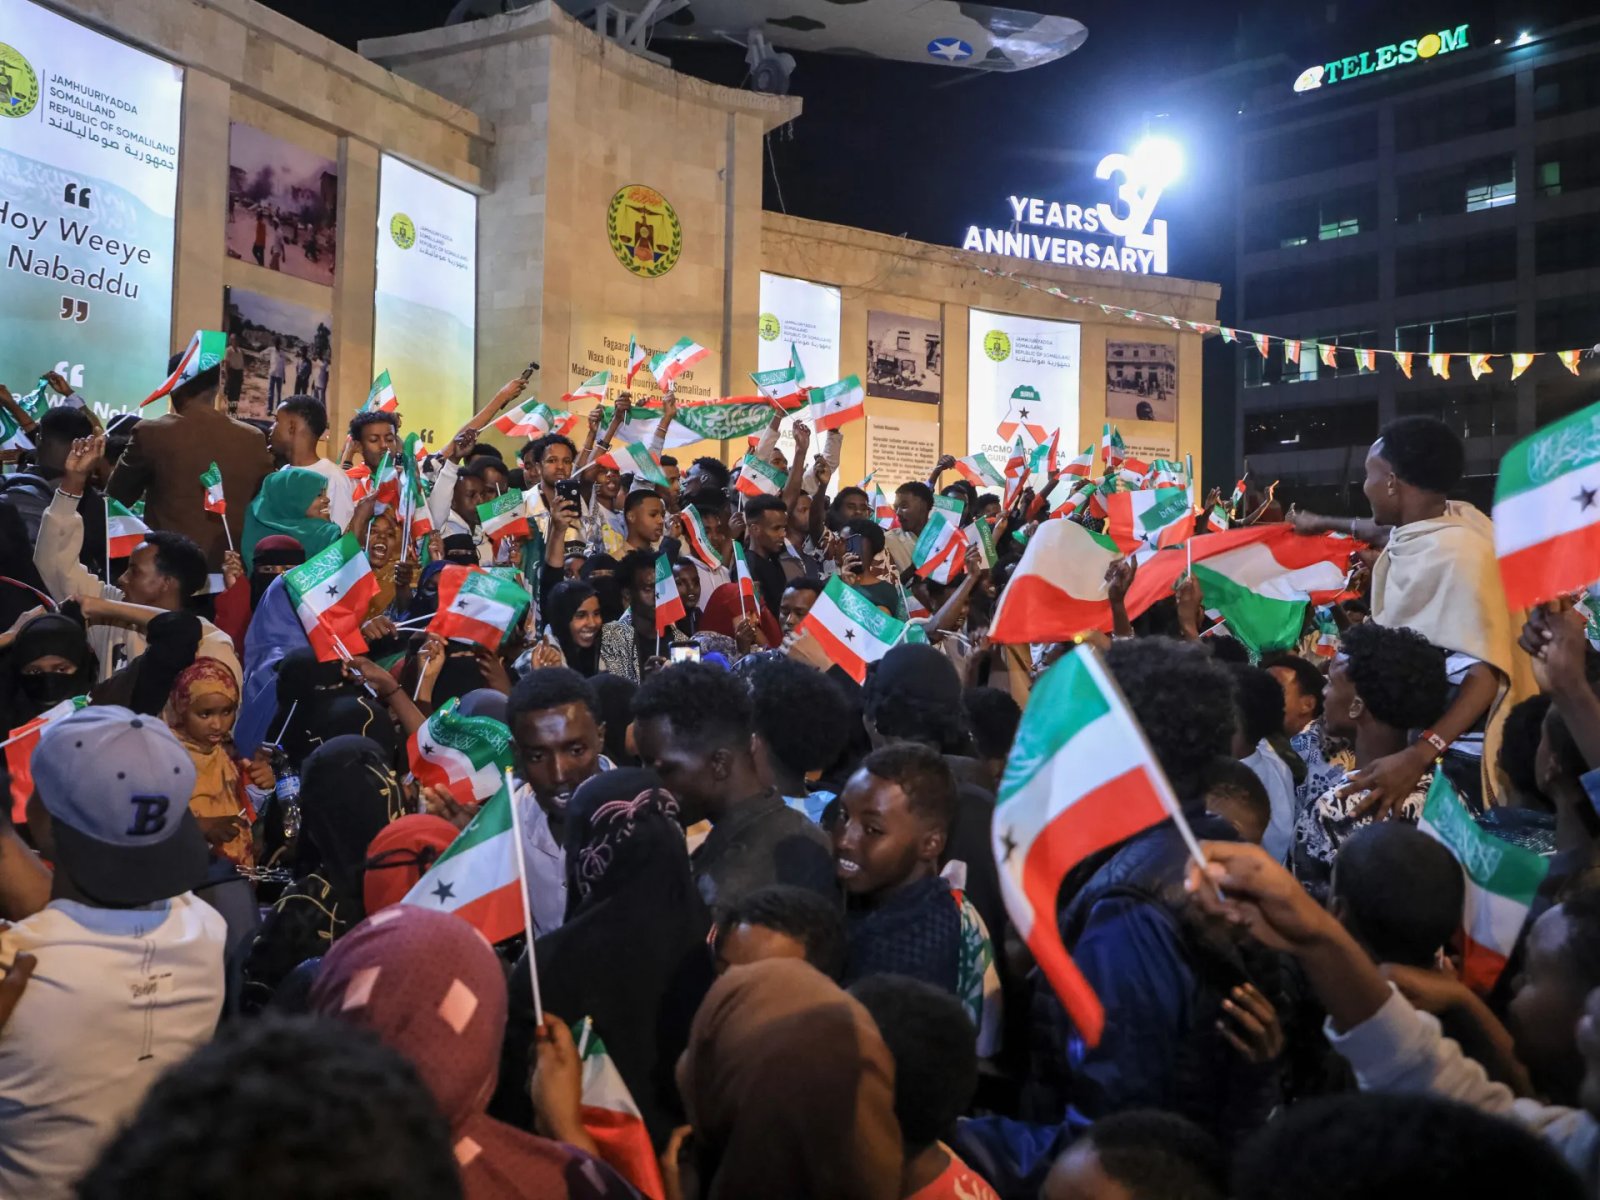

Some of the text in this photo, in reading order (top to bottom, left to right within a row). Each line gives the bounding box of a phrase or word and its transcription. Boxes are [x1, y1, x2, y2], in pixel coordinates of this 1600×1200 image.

[1325, 24, 1469, 84] TELESOM
[50, 74, 138, 115] JAMHUURIYADDA
[50, 87, 116, 119] SOMALILAND
[49, 101, 176, 156] REPUBLIC OF SOMALILAND
[1010, 195, 1099, 232] YEARS
[60, 217, 151, 265] Weeye
[963, 225, 1155, 274] ANNIVERSARY
[8, 244, 138, 299] Nabaddu
[606, 355, 616, 366] dib
[673, 382, 711, 397] Somaliland
[125, 794, 170, 836] B
